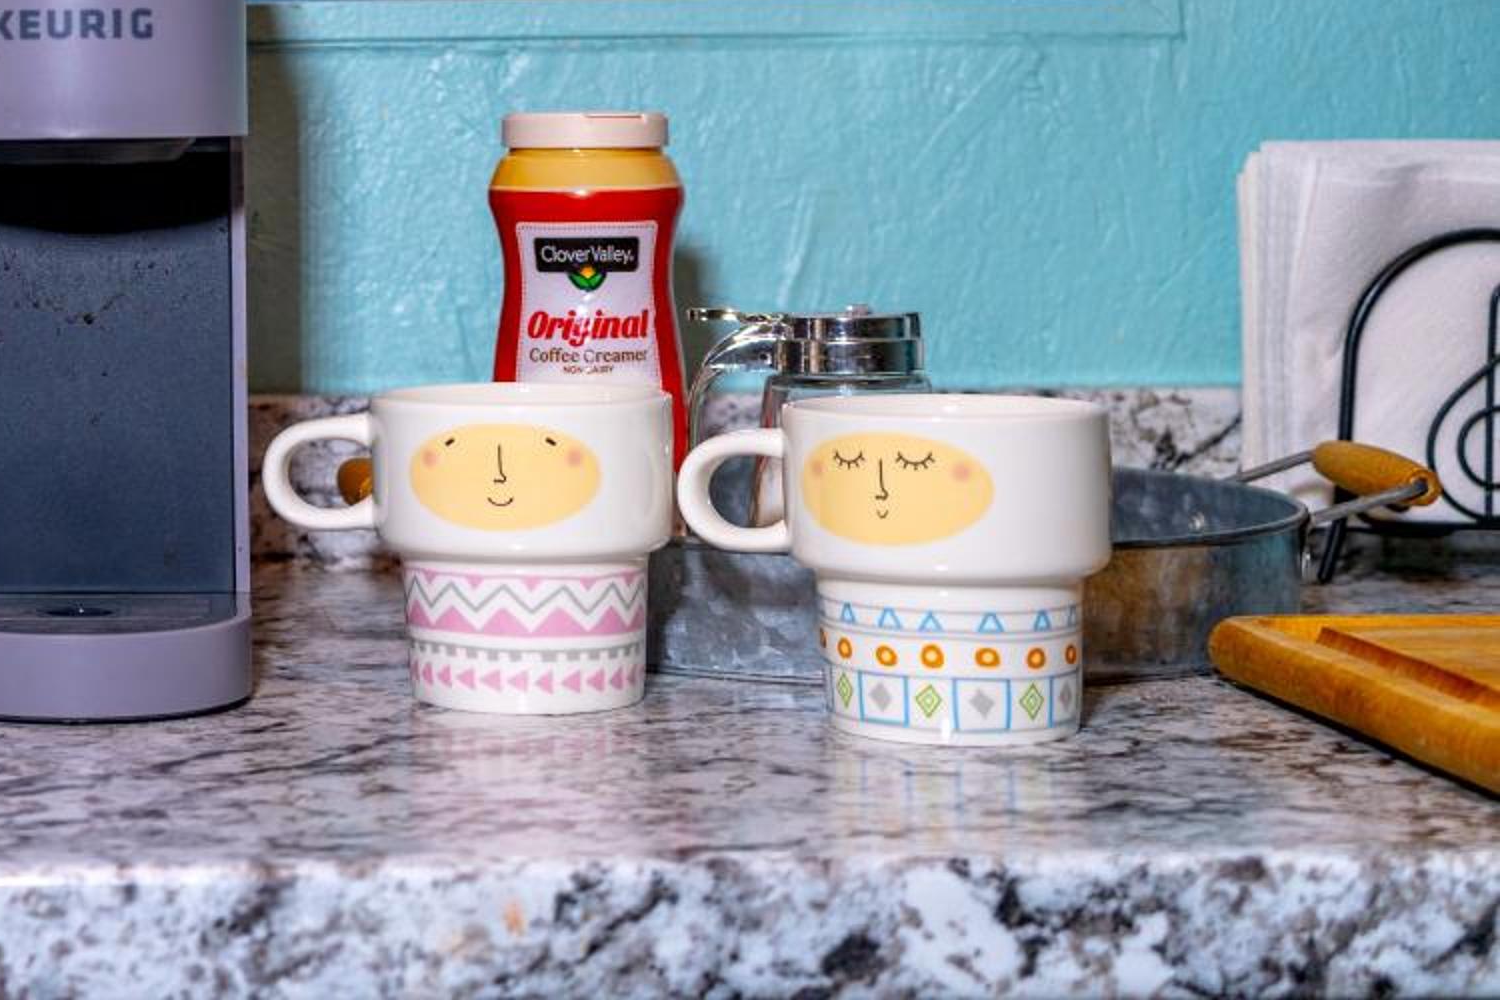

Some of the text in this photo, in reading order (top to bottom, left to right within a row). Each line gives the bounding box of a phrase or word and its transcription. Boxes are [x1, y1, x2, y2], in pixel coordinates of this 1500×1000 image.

[541, 245, 630, 265] Clover Valley
[527, 309, 648, 347] Original
[529, 347, 647, 363] Coffee Creamer
